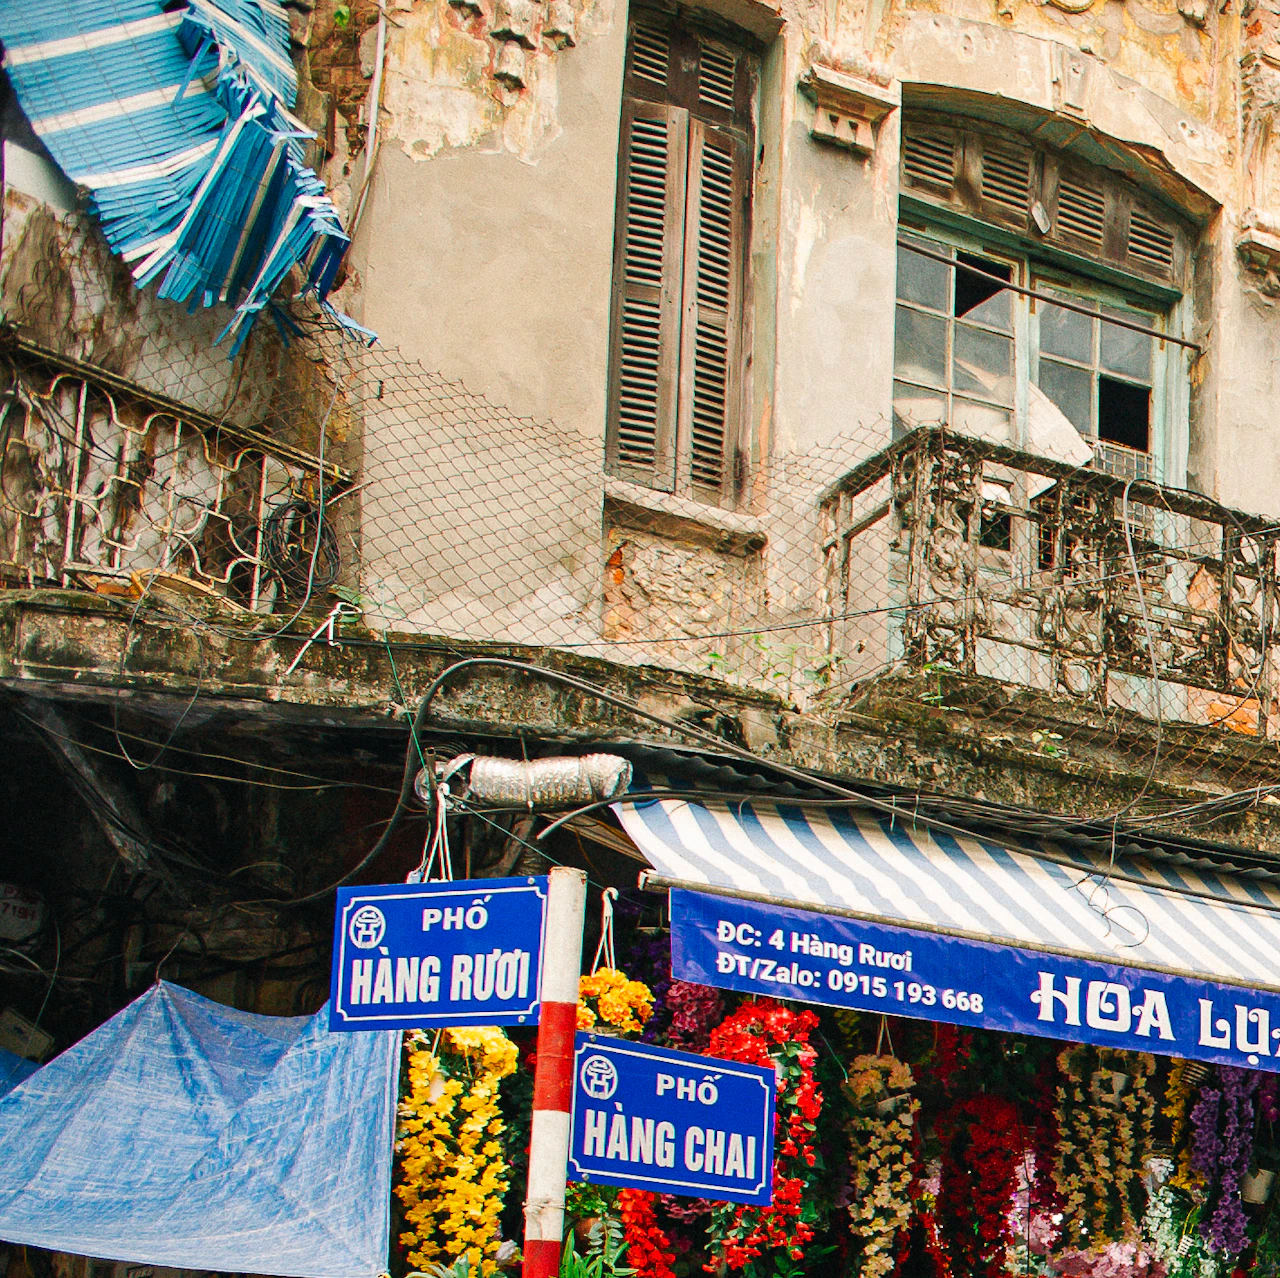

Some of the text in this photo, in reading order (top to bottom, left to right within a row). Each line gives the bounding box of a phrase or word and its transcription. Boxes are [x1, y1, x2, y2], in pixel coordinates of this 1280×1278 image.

[422, 895, 492, 931] PHỐ
[350, 946, 530, 1005] HÀNG RƯƠI
[717, 920, 913, 972] ĐC: 4 Hàng Rươi
[717, 952, 984, 1014] ĐT/Zalo: 0915 193 668
[1030, 971, 1176, 1041] HOA
[656, 1073, 722, 1106] PHỐ
[583, 1102, 756, 1180] HÀNG CHAI
